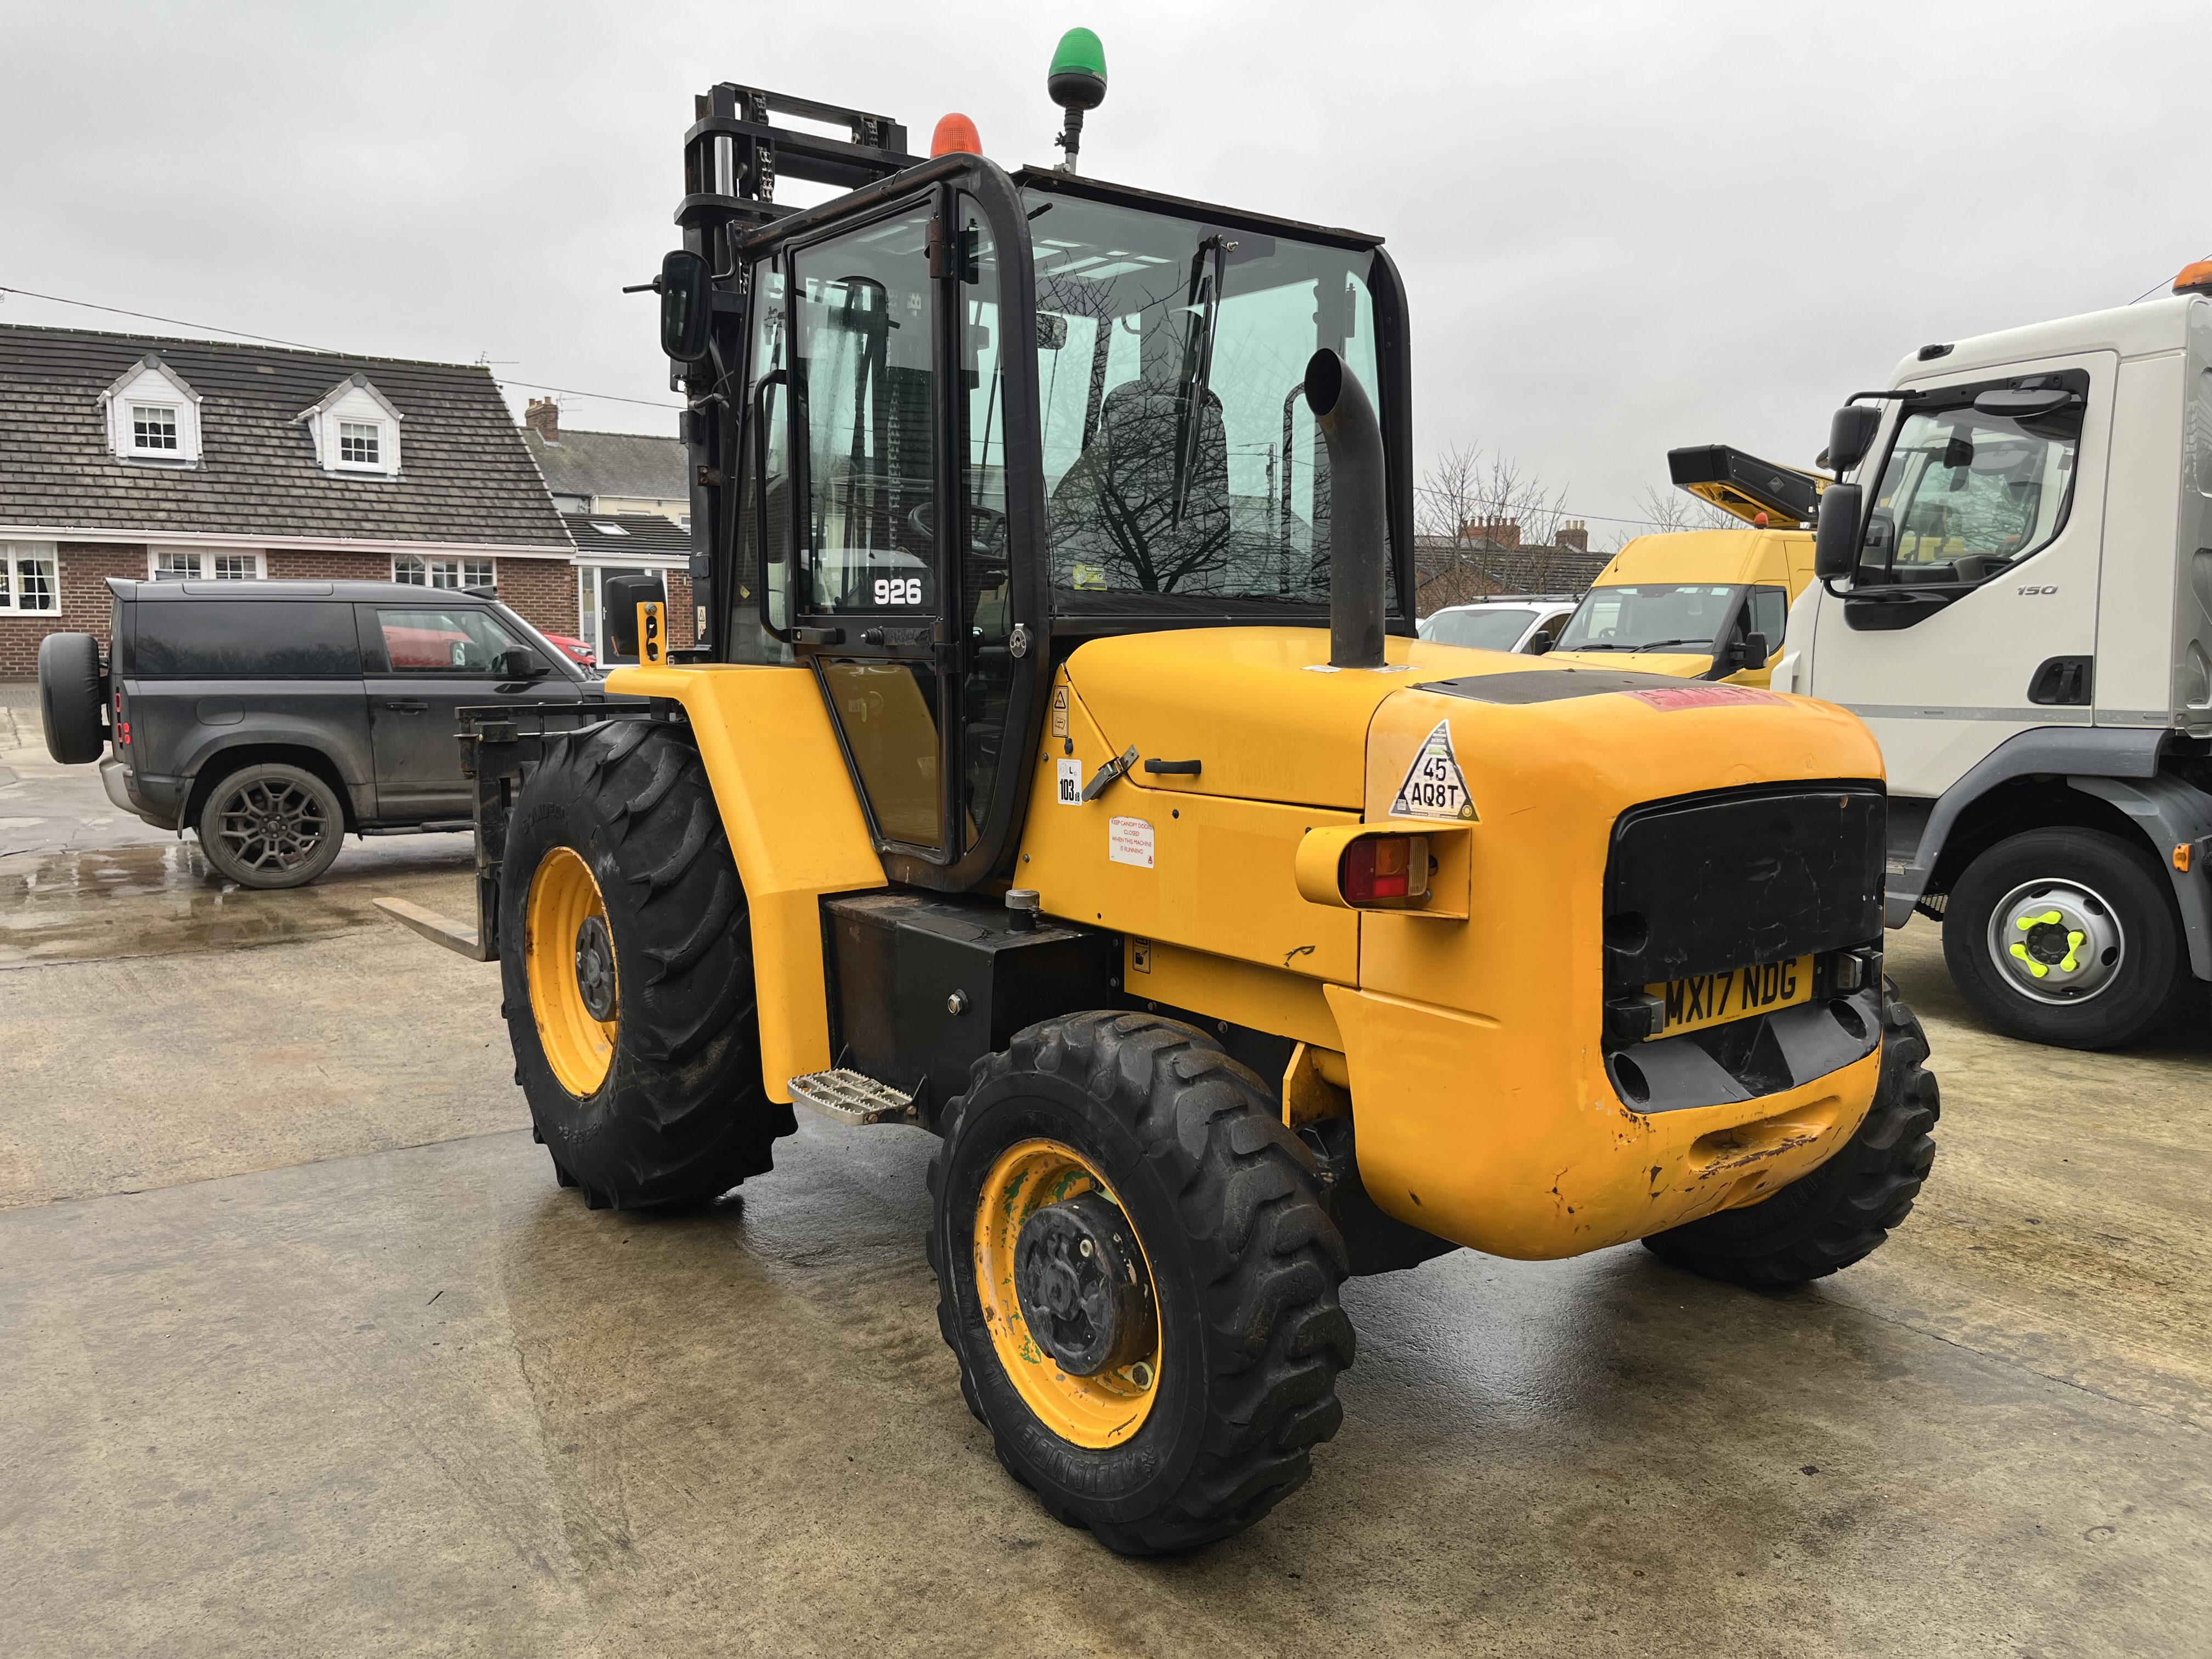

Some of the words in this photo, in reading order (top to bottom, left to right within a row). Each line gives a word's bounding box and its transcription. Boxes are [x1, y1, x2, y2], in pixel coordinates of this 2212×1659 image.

[874, 578, 921, 605] 926
[2017, 585, 2058, 595] 150
[1424, 757, 1447, 781] 45
[1060, 778, 1074, 801] 103
[1411, 782, 1458, 808] AQ8T
[1664, 970, 1734, 1028] MX17
[1741, 958, 1797, 1010] NDG
